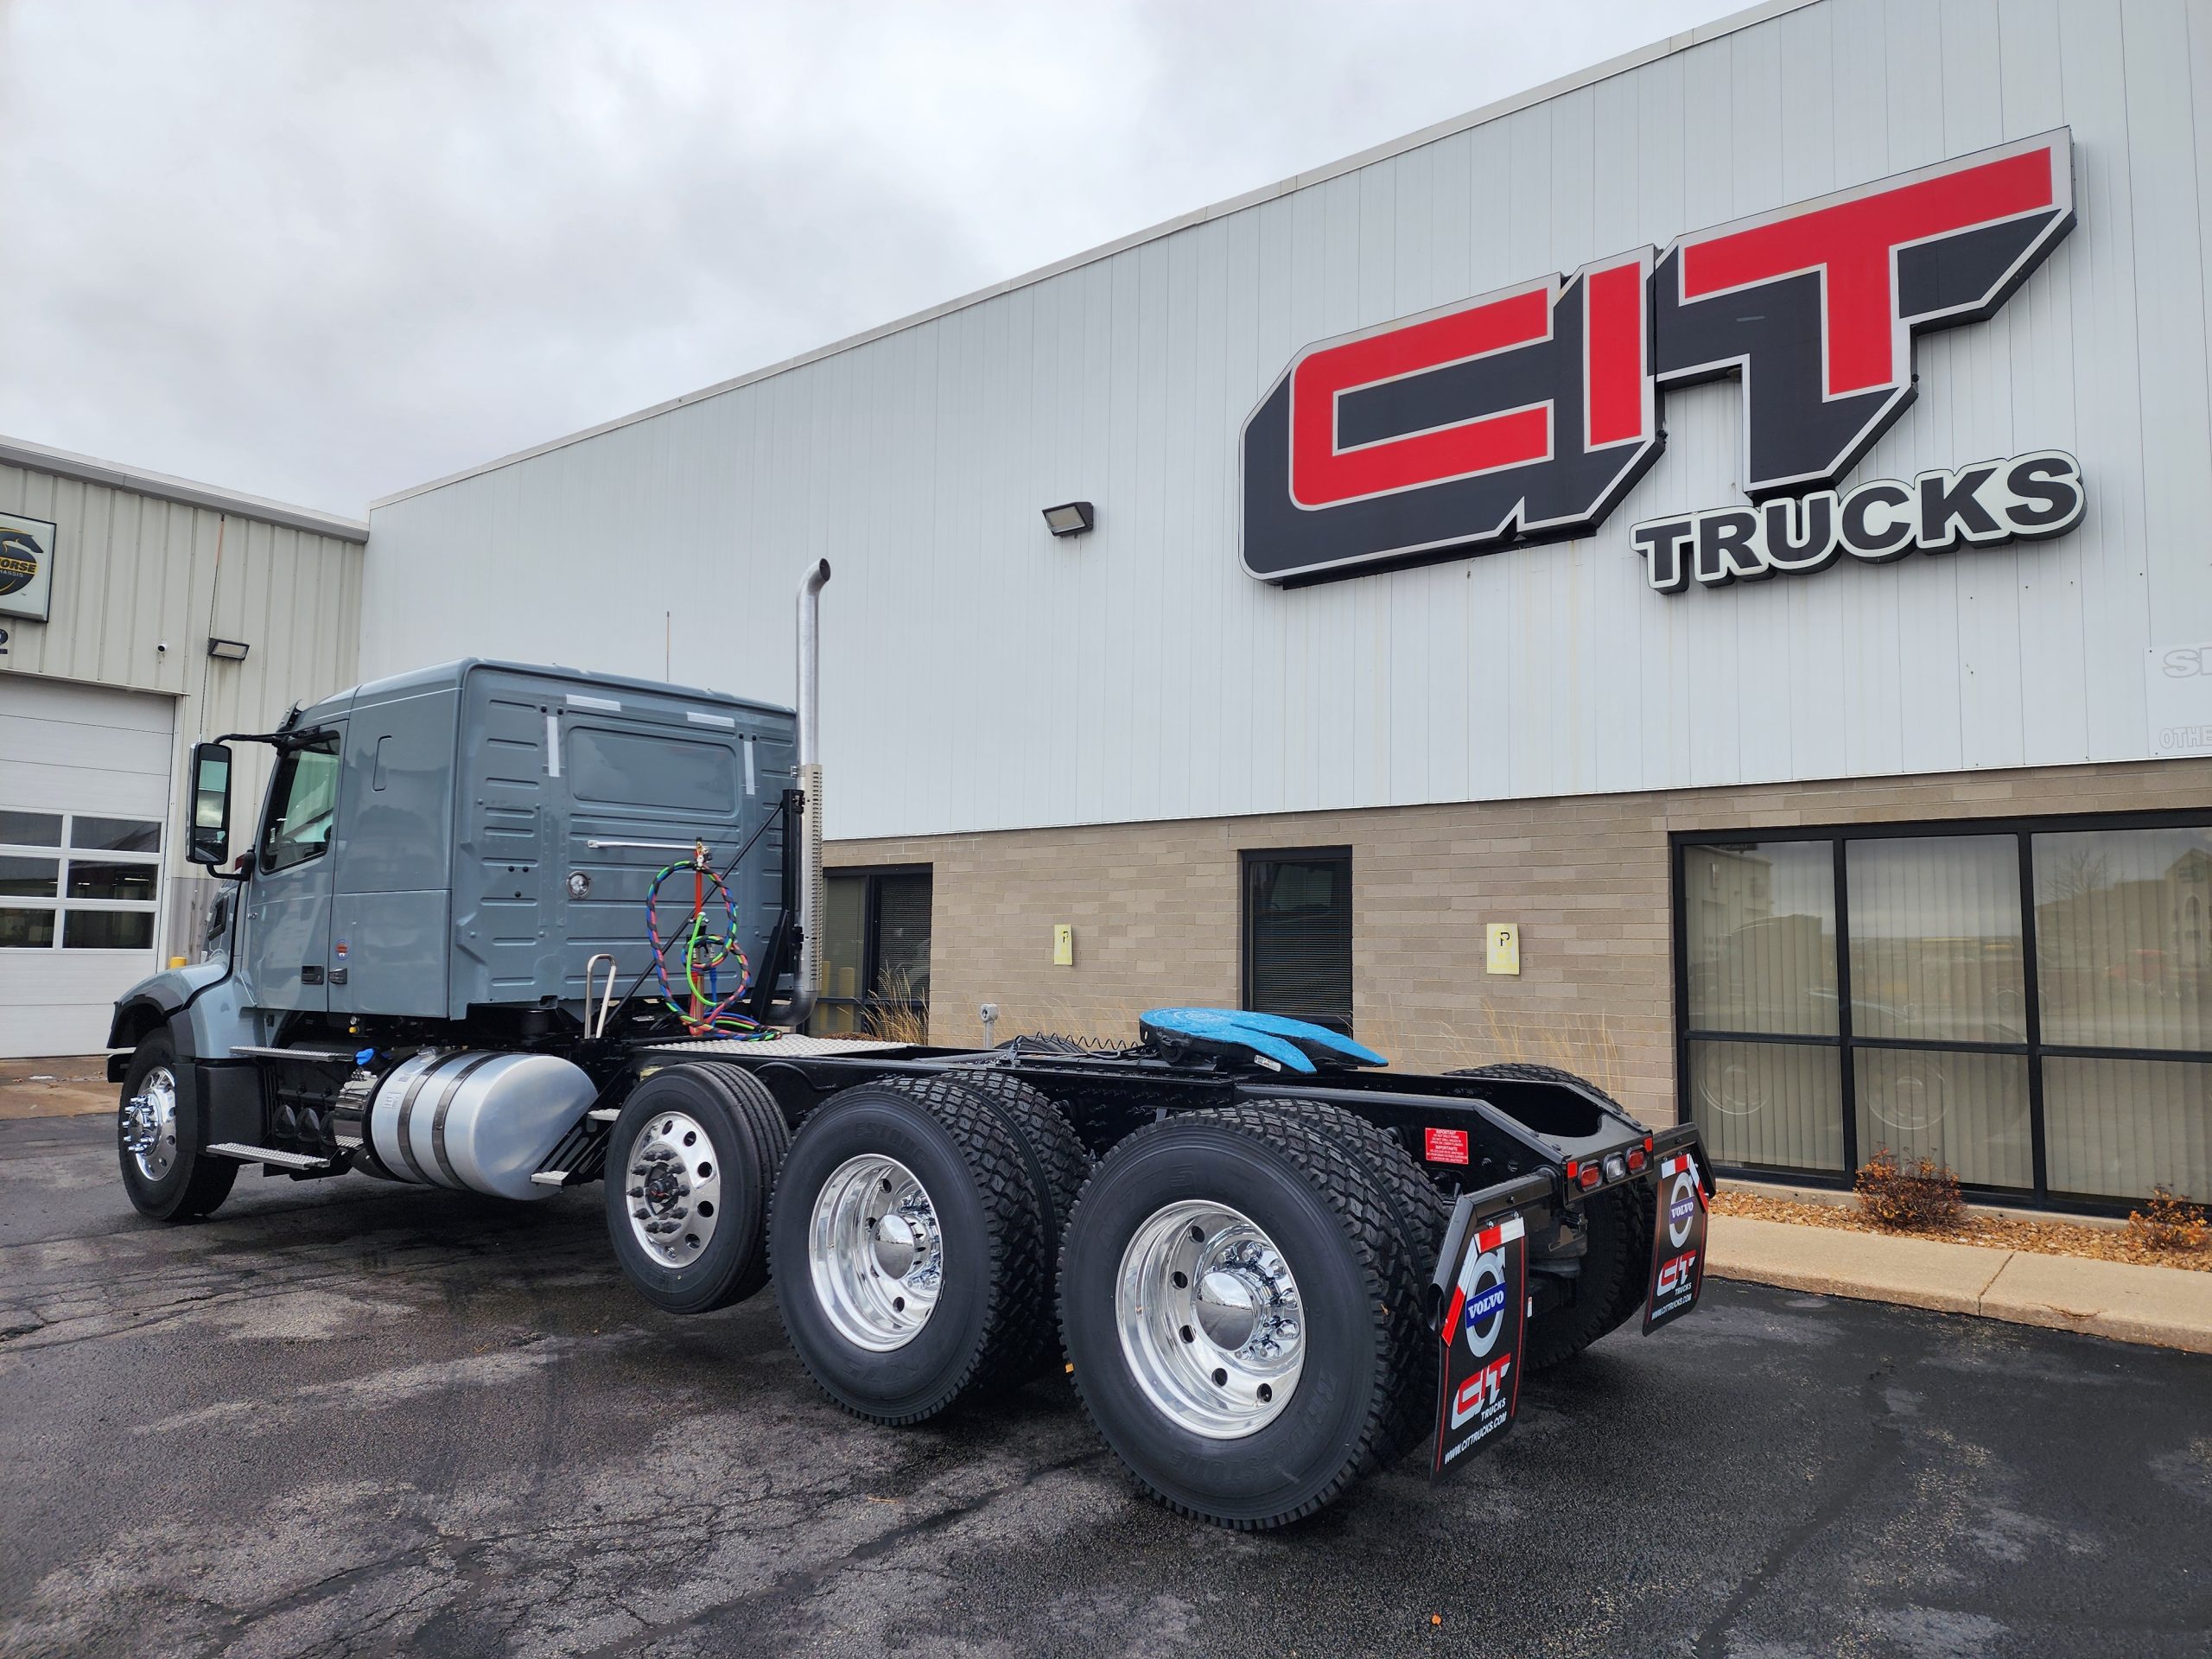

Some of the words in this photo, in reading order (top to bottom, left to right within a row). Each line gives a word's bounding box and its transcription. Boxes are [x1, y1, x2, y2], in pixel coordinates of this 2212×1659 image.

[1246, 128, 2074, 562] CIT
[1635, 456, 2079, 584] TRUCKS
[0, 558, 36, 573] ORSE
[1671, 1201, 1694, 1218] VOLVO
[1658, 1249, 1696, 1294] CIT
[1675, 1281, 1692, 1296] TRUCKS
[1468, 1289, 1504, 1319] VOLVO
[1453, 1352, 1511, 1427] CIT
[1481, 1397, 1507, 1422] TRUCKS
[1444, 1410, 1508, 1465] WWW.CITTRUCKS.COM
